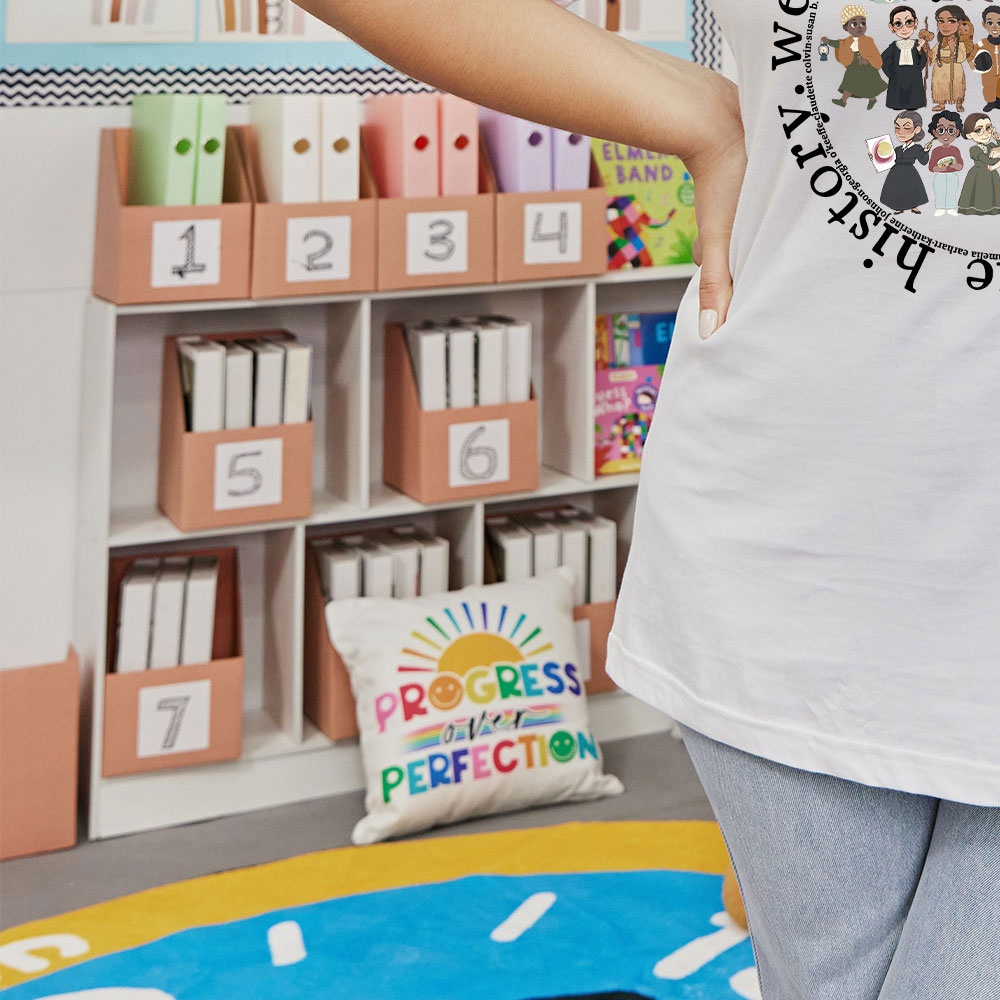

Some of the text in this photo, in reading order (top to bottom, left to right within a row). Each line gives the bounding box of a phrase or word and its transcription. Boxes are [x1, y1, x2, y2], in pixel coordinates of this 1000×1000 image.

[616, 165, 673, 184] BAND
[778, 85, 934, 293] history.
[171, 224, 207, 279] 1
[301, 228, 335, 272] 2
[423, 218, 457, 262] 3
[531, 210, 569, 254] 4
[225, 449, 265, 497] 5
[457, 425, 499, 482] 6
[156, 696, 191, 749] 7
[374, 661, 582, 734] PROGRESS
[443, 708, 529, 744] over
[381, 729, 600, 803] PERFECTION
